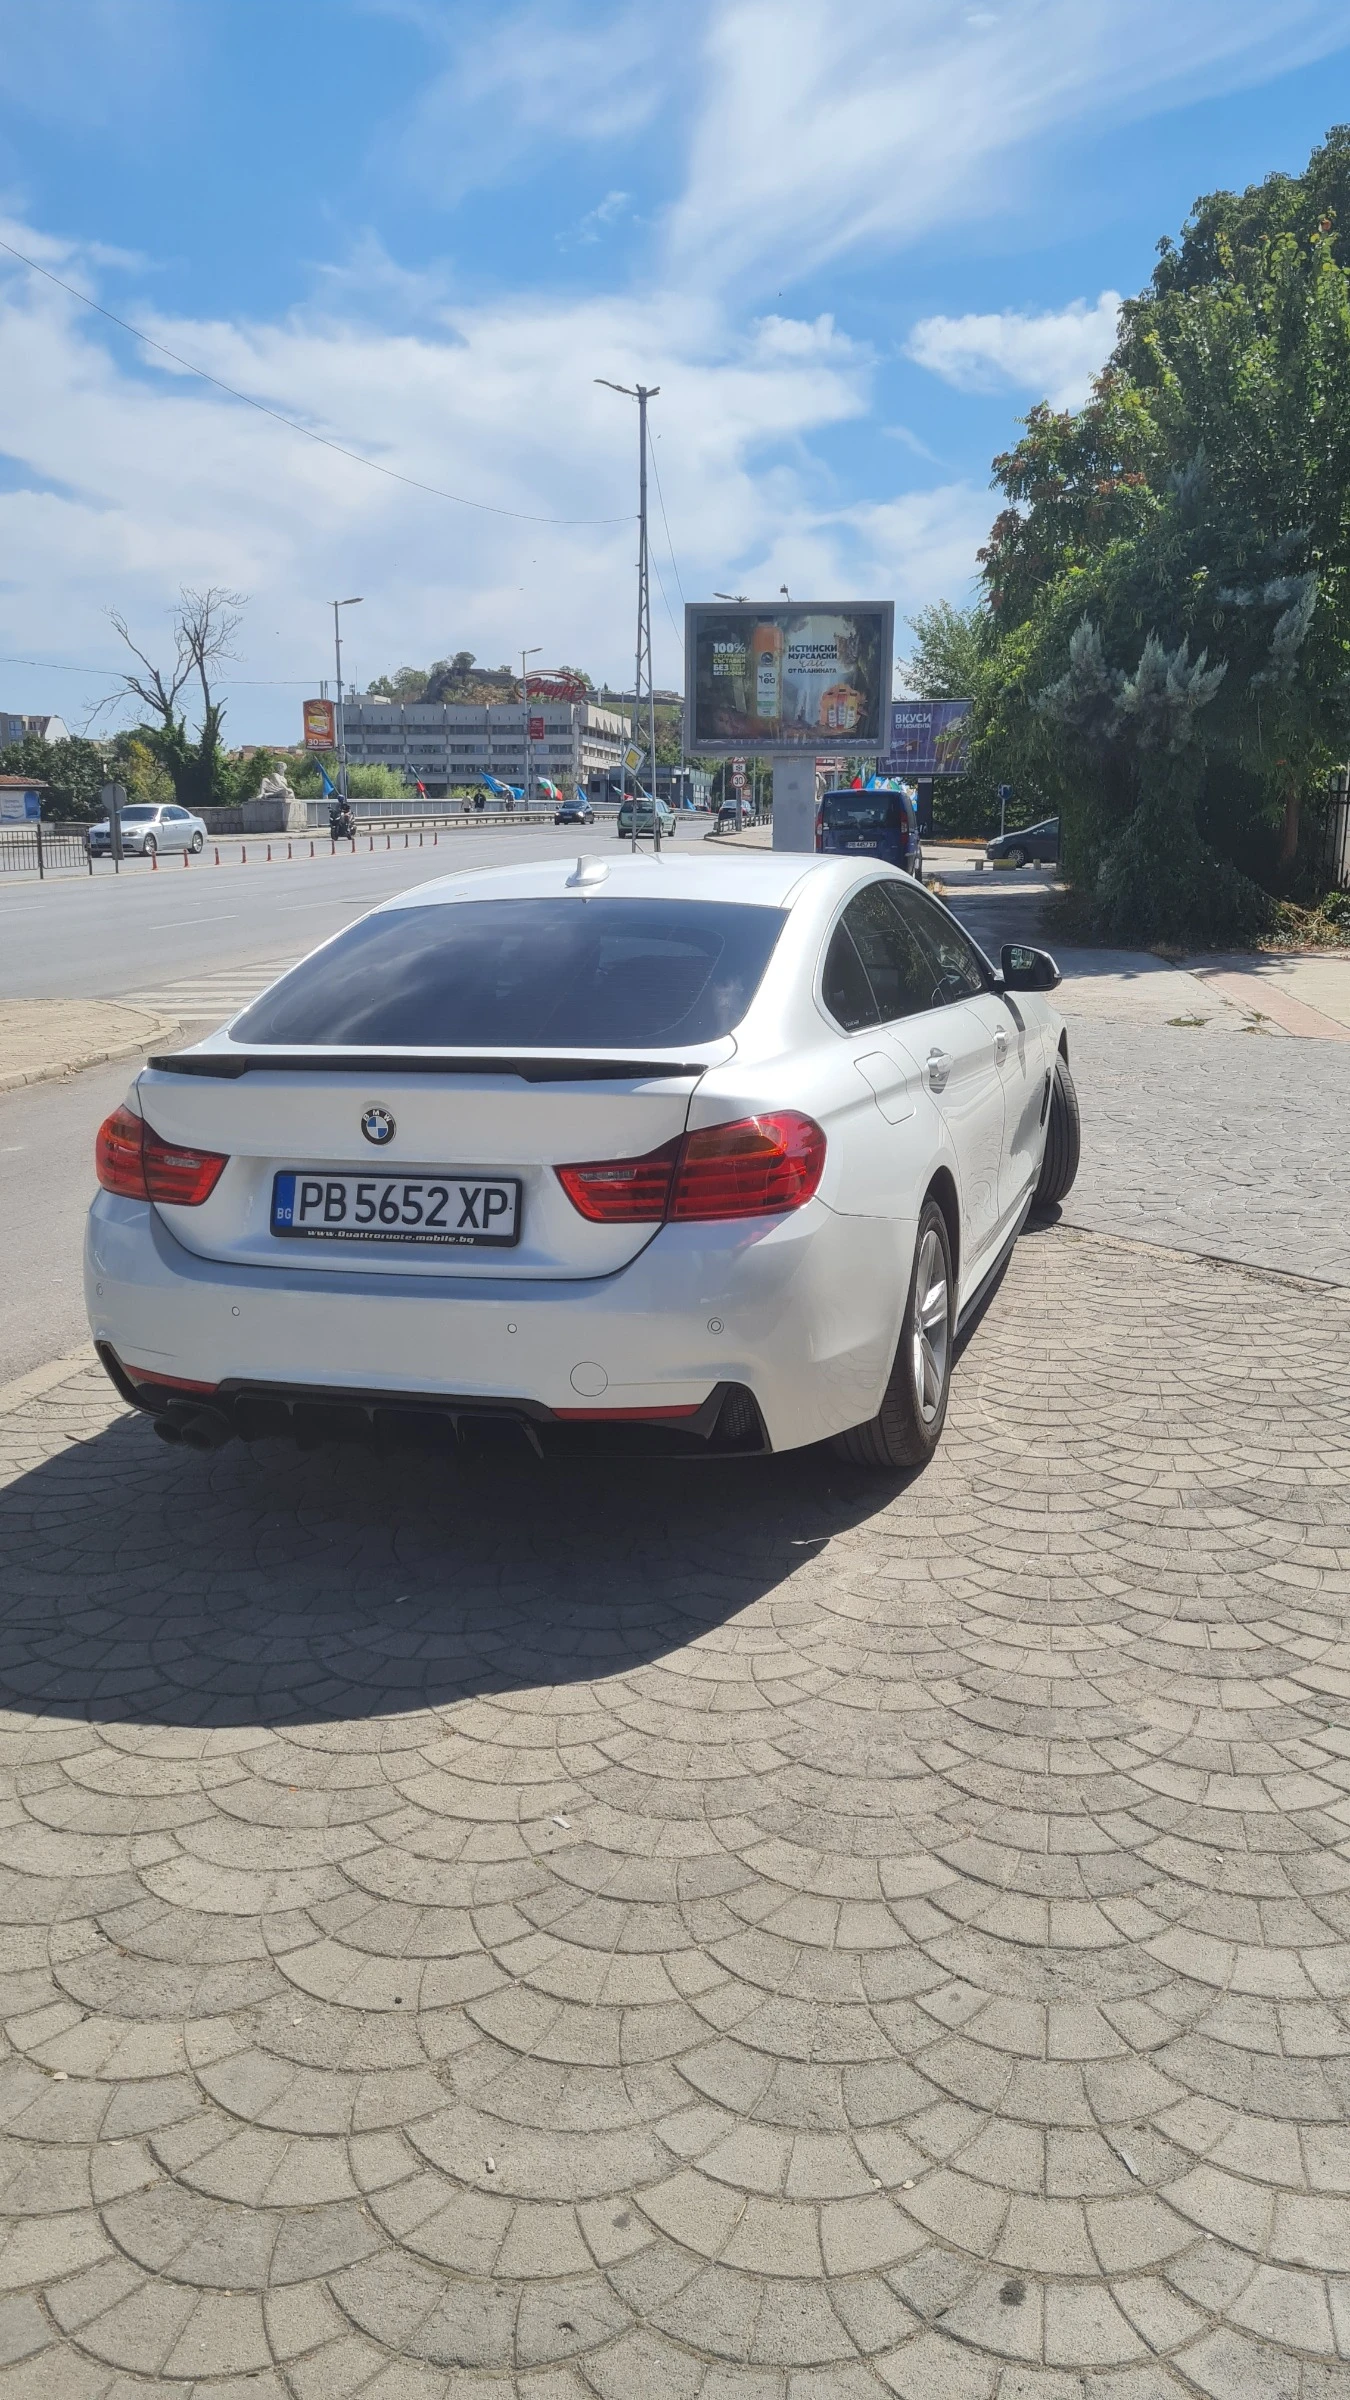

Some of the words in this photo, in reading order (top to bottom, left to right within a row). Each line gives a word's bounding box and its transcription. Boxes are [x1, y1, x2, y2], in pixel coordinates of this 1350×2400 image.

[713, 642, 746, 653] 100%
[788, 644, 837, 652] ИСТИНСКИ
[788, 652, 837, 660] МУРСАЛСКИ
[524, 677, 577, 701] Happy
[895, 713, 932, 724] ВКУСИ
[307, 738, 319, 746] 30
[734, 776, 743, 785] 30
[362, 1109, 392, 1122] BMW
[299, 1182, 347, 1223] PB
[355, 1183, 449, 1227] 5652
[457, 1187, 508, 1228] XP
[276, 1207, 292, 1220] BG
